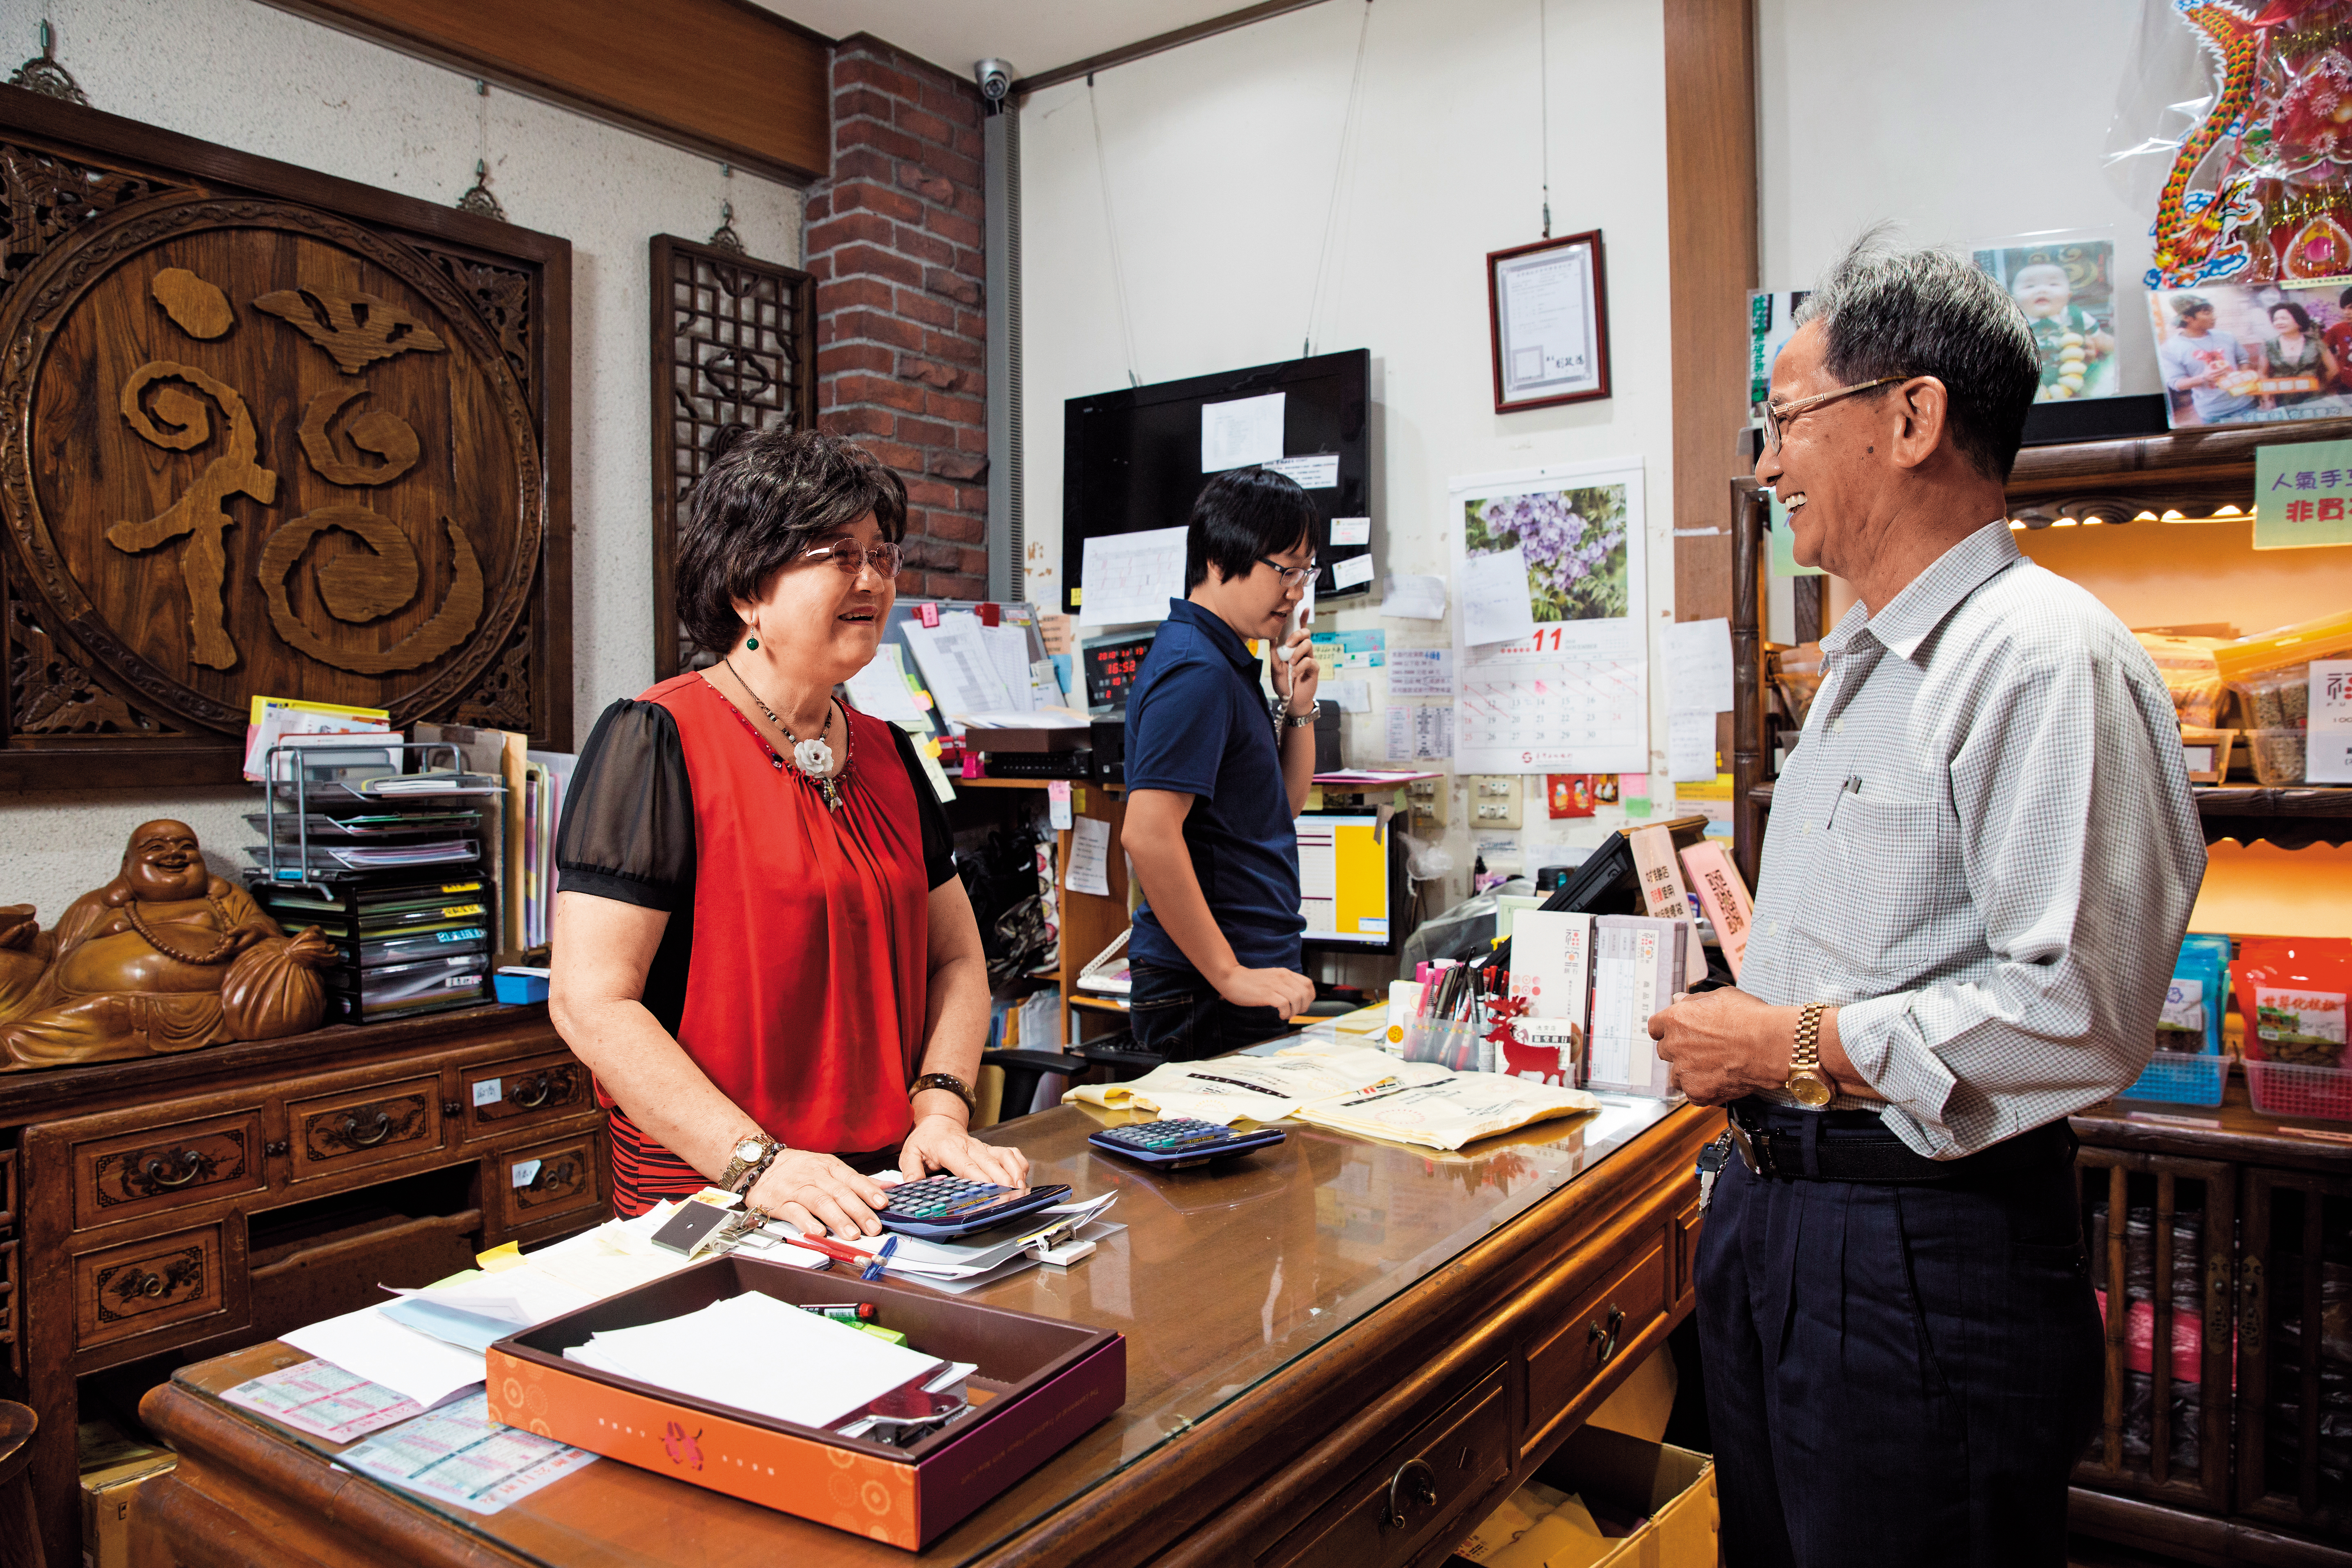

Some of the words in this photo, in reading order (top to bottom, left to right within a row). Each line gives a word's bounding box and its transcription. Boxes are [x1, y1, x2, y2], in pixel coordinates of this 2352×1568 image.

[2272, 469, 2352, 491] 人氣手
[2286, 497, 2352, 523] 非買
[1533, 628, 1562, 652] 11
[1108, 660, 1136, 674] 16:52
[1106, 690, 1111, 698] 2
[1641, 981, 1650, 1034] 商品訂購單
[958, 1200, 976, 1208] PROTECT
